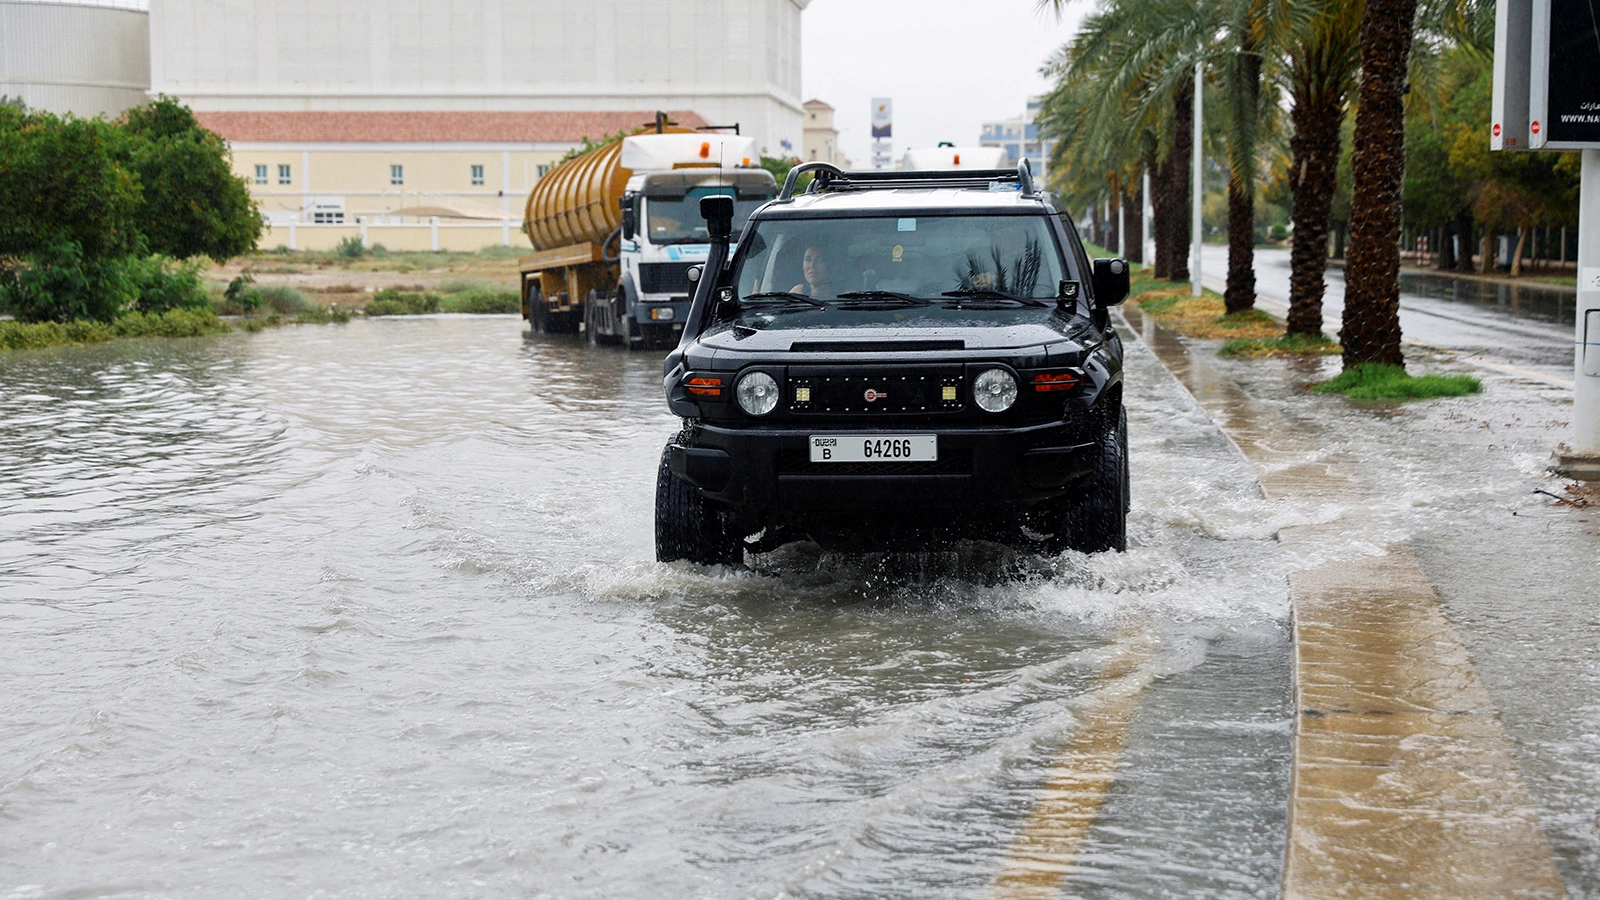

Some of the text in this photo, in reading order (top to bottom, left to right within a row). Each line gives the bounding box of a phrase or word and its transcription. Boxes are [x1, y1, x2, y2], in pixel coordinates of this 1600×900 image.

[1560, 114, 1600, 123] WWW.NA
[822, 448, 832, 460] B
[863, 439, 911, 458] 64266
